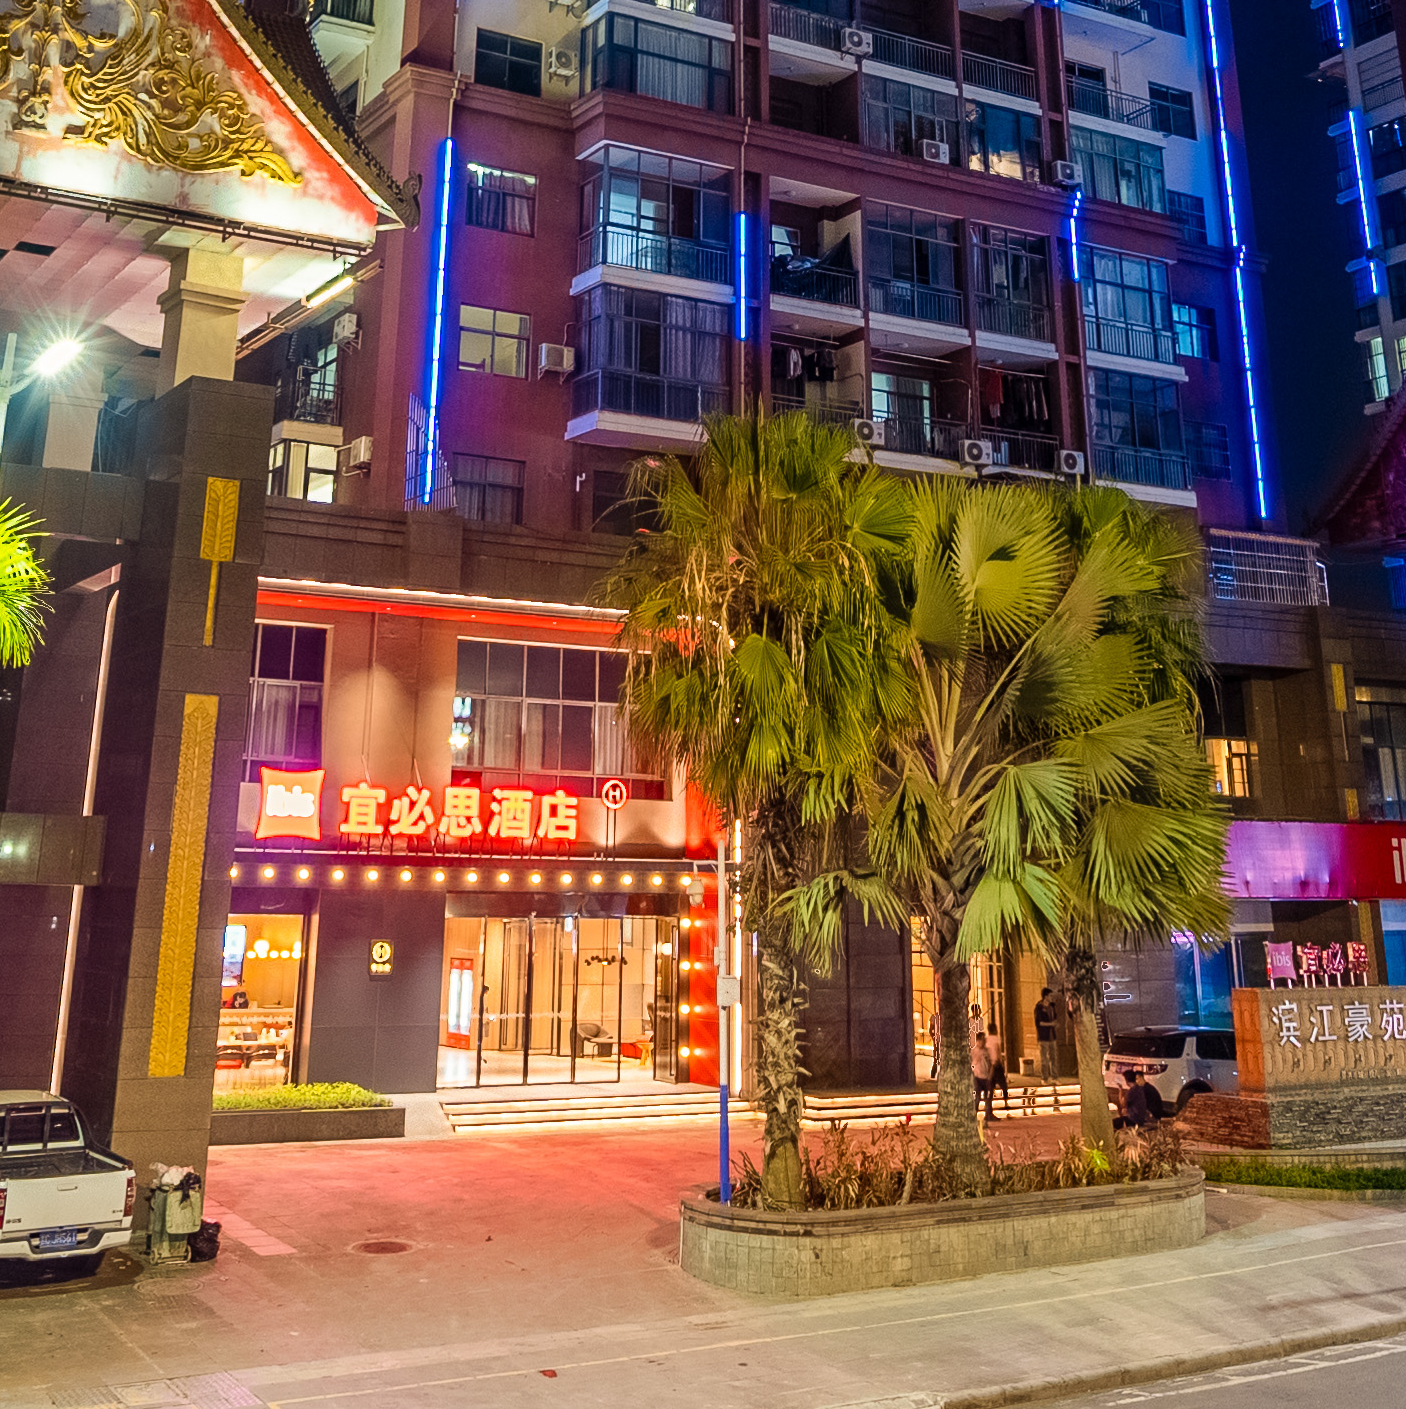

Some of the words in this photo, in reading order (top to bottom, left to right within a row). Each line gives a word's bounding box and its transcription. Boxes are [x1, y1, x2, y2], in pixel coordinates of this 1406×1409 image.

[339, 781, 578, 840] 宜必思酒店
[1271, 950, 1292, 967] ibis
